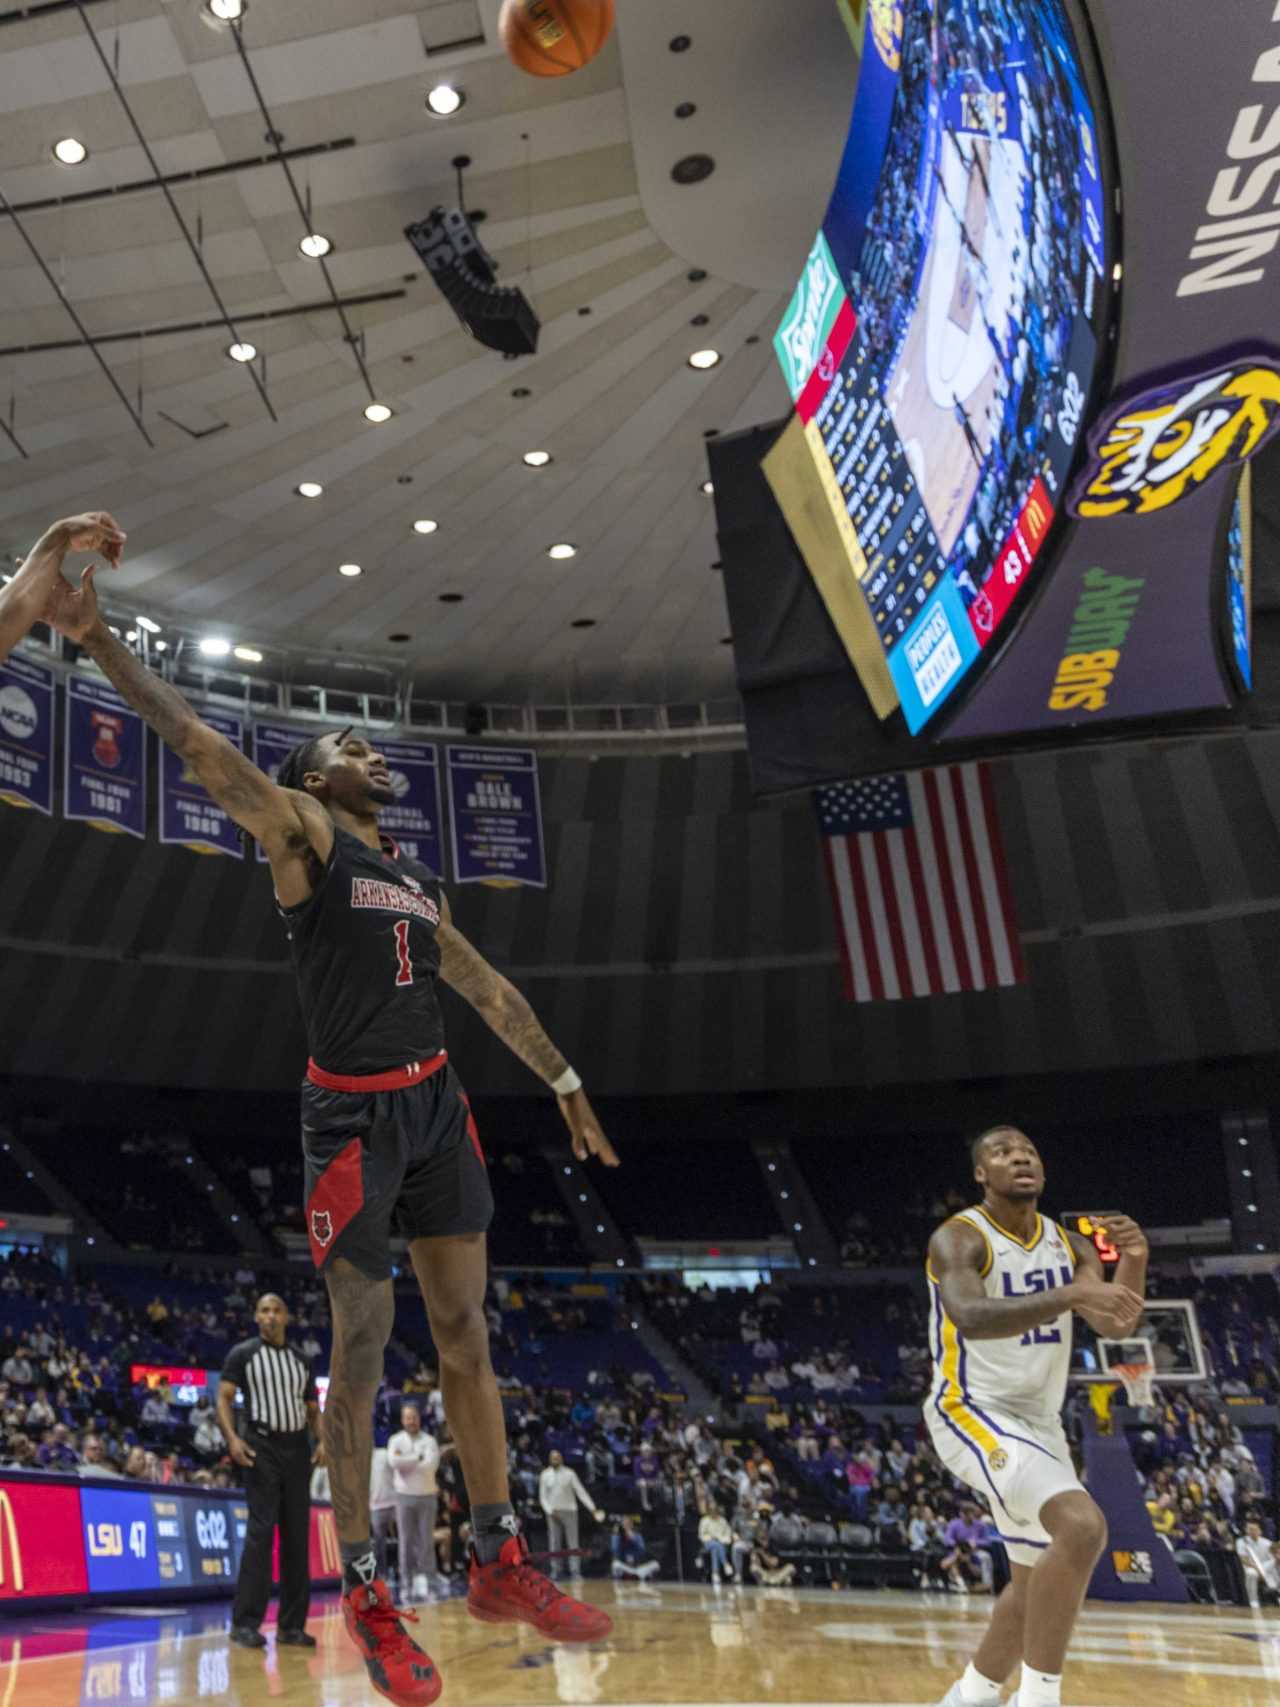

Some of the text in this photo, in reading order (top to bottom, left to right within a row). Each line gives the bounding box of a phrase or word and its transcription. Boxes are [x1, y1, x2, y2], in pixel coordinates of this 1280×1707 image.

[1176, 0, 1280, 297] NISS
[1048, 567, 1145, 711] SUBWAY
[176, 799, 202, 816] FINAL
[393, 919, 413, 986] 1
[1002, 1265, 1073, 1298] LSU
[87, 1522, 123, 1557] LSU
[129, 1520, 148, 1559] 47
[195, 1508, 229, 1550] 6:02
